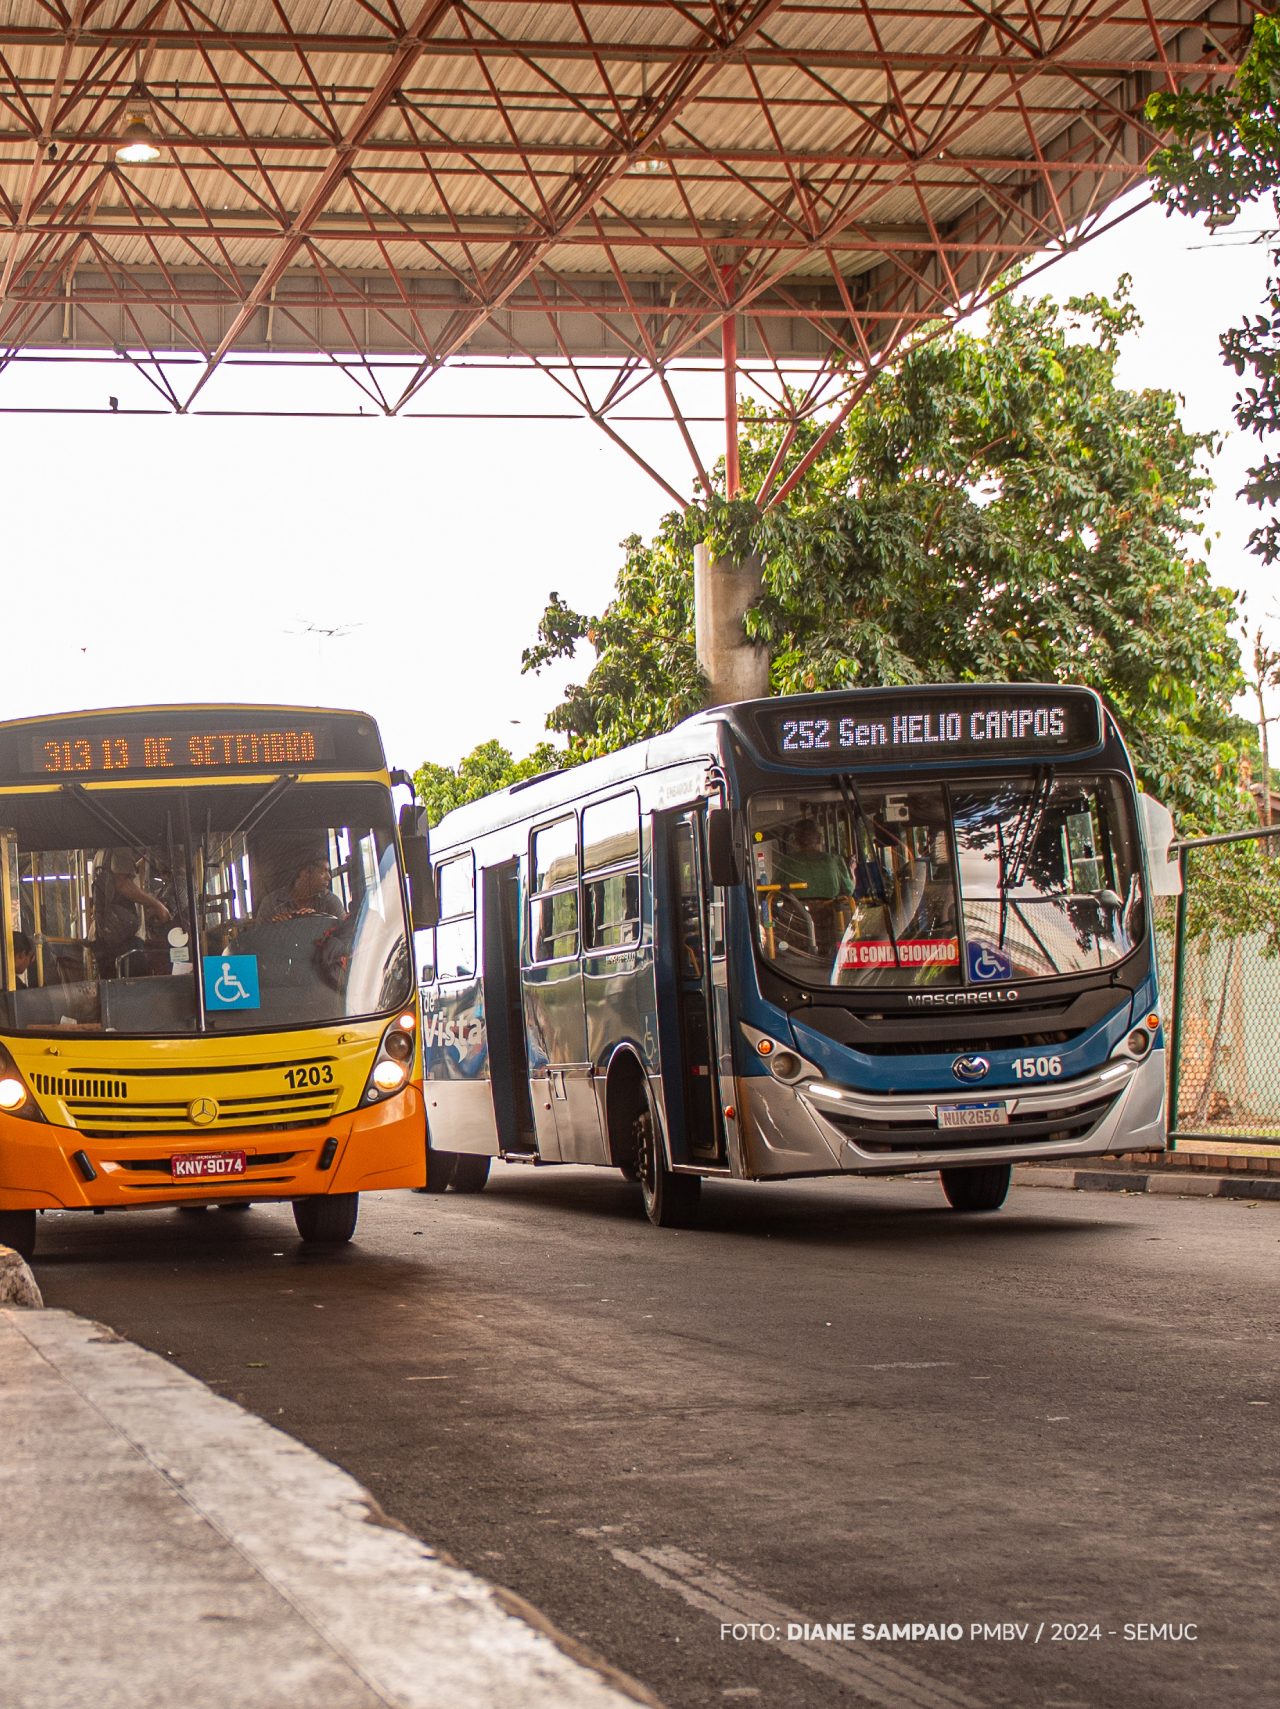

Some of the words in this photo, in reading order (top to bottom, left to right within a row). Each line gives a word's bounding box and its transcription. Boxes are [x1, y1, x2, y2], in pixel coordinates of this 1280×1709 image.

[783, 720, 830, 749] 252
[839, 718, 887, 746] Sen
[892, 713, 962, 743] HELIO
[970, 708, 1065, 740] CAMPOS
[44, 740, 91, 772] 313
[101, 739, 128, 770] 13
[144, 737, 175, 768] DE
[188, 732, 315, 766] SETEMBRO
[907, 990, 1019, 1006] MASCARELLO
[423, 1011, 483, 1048] Vista
[284, 1065, 334, 1089] 1203
[1011, 1056, 1062, 1078] 1506
[943, 1109, 1000, 1126] NUK2G56
